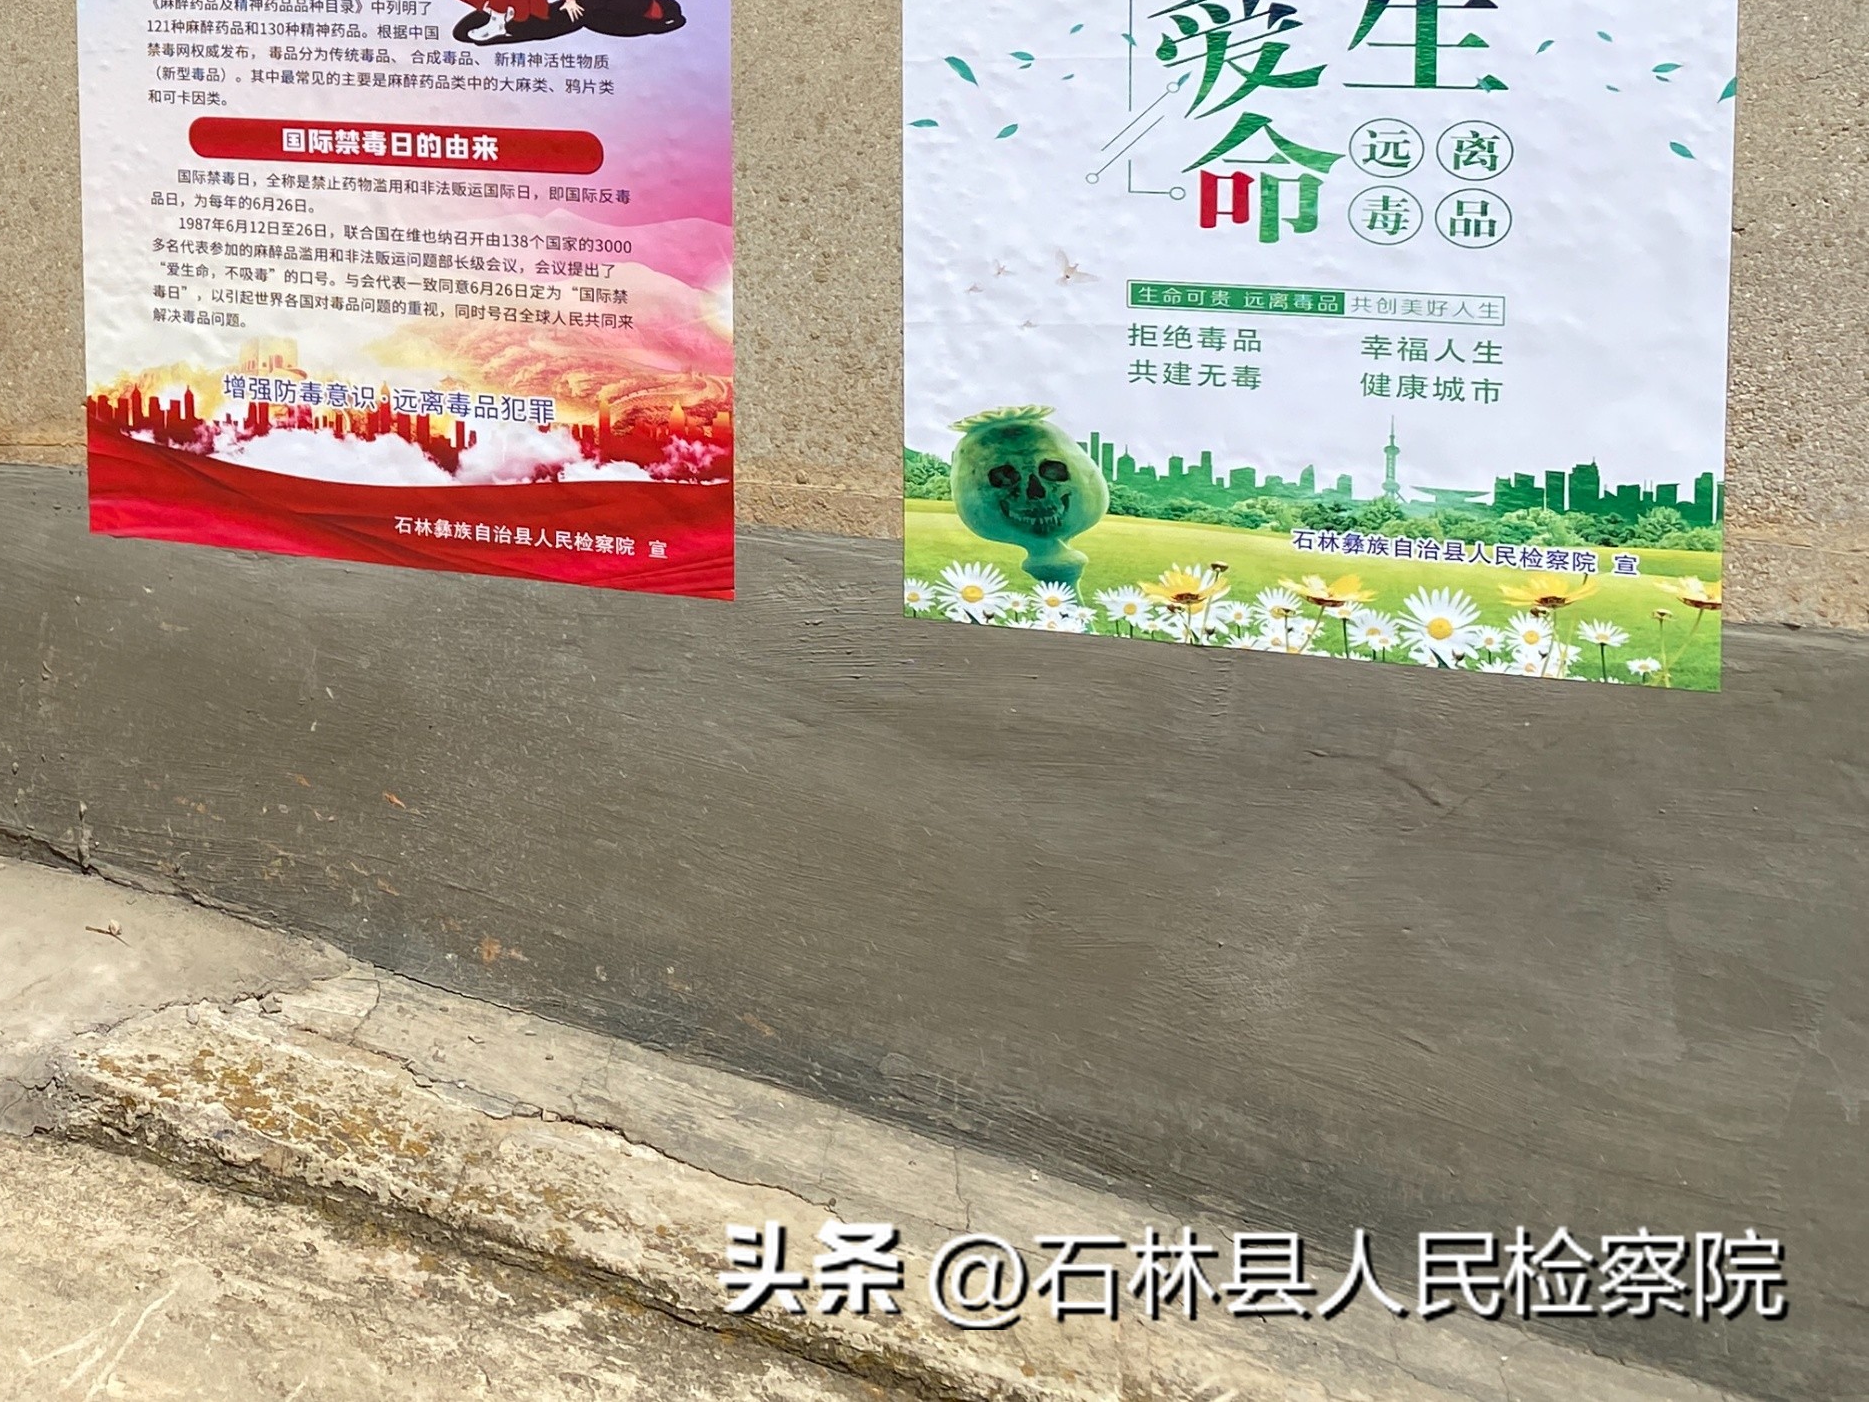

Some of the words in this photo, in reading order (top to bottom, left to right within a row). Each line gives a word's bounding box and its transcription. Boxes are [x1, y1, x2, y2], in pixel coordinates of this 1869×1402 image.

[148, 90, 228, 106] 和可卡因类。
[282, 128, 498, 161] 国际禁毒日的由来
[1137, 286, 1232, 307] 生命可贵
[1243, 291, 1339, 312] 远离毒品
[1350, 295, 1501, 320] 共创美好人生
[1128, 323, 1262, 353] 拒绝毒品
[1360, 334, 1503, 365] 幸福人生
[1128, 359, 1262, 390] 共建无毒
[1360, 372, 1503, 404] 健康城市
[394, 516, 635, 556] 石林彝族自治县人民检察院
[648, 539, 668, 559] 宣
[1293, 530, 1596, 573] 石林彝族自治县人民检察院
[1614, 555, 1638, 575] 宣
